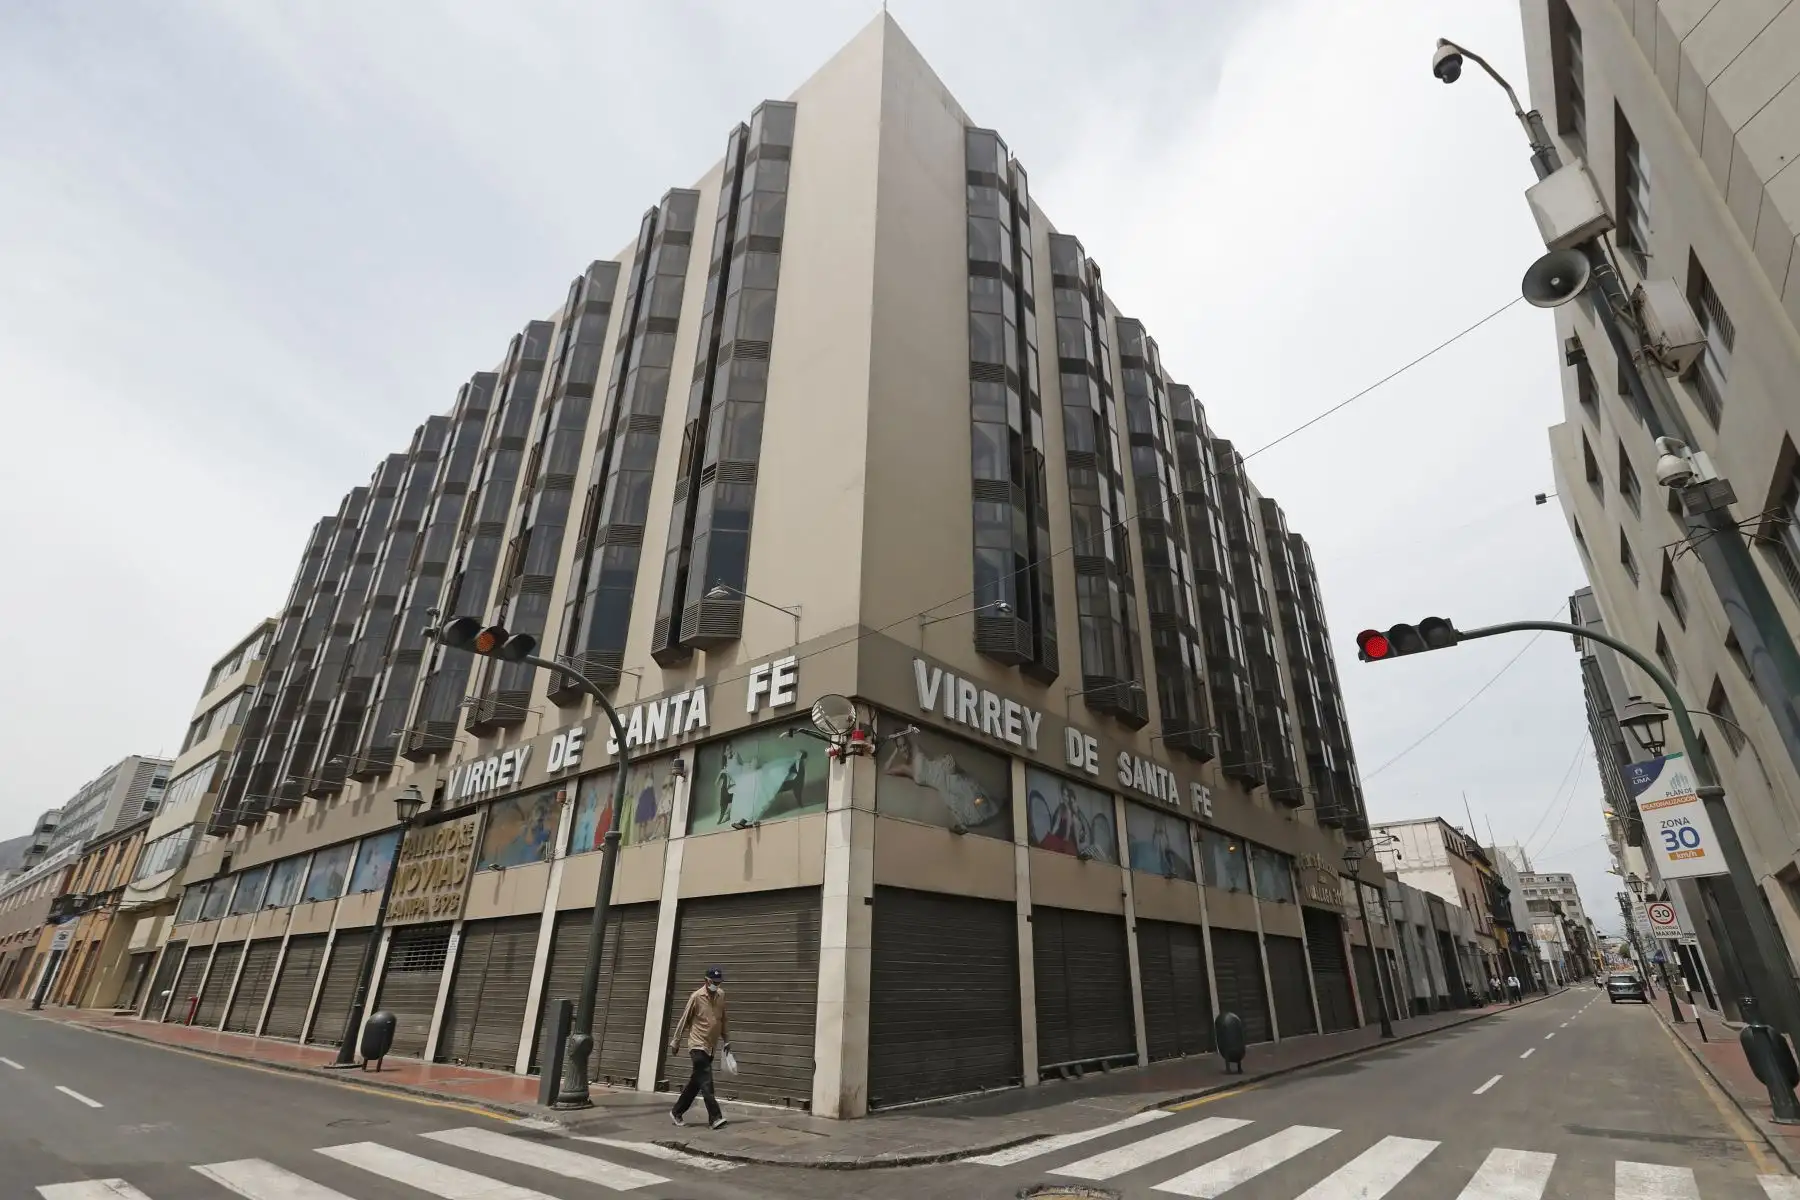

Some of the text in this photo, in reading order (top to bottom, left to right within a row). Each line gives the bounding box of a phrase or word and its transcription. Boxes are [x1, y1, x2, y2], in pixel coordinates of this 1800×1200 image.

[447, 655, 799, 800] VIRREY DE SANTA FE
[913, 658, 1213, 818] VIRREY DE SANTA FE
[1665, 788, 1684, 797] PLAN
[1660, 816, 1691, 829] ZONA
[1660, 826, 1700, 851] 30
[1676, 850, 1698, 859] km/h
[392, 853, 469, 895] NOVIAS
[1654, 909, 1670, 918] 30
